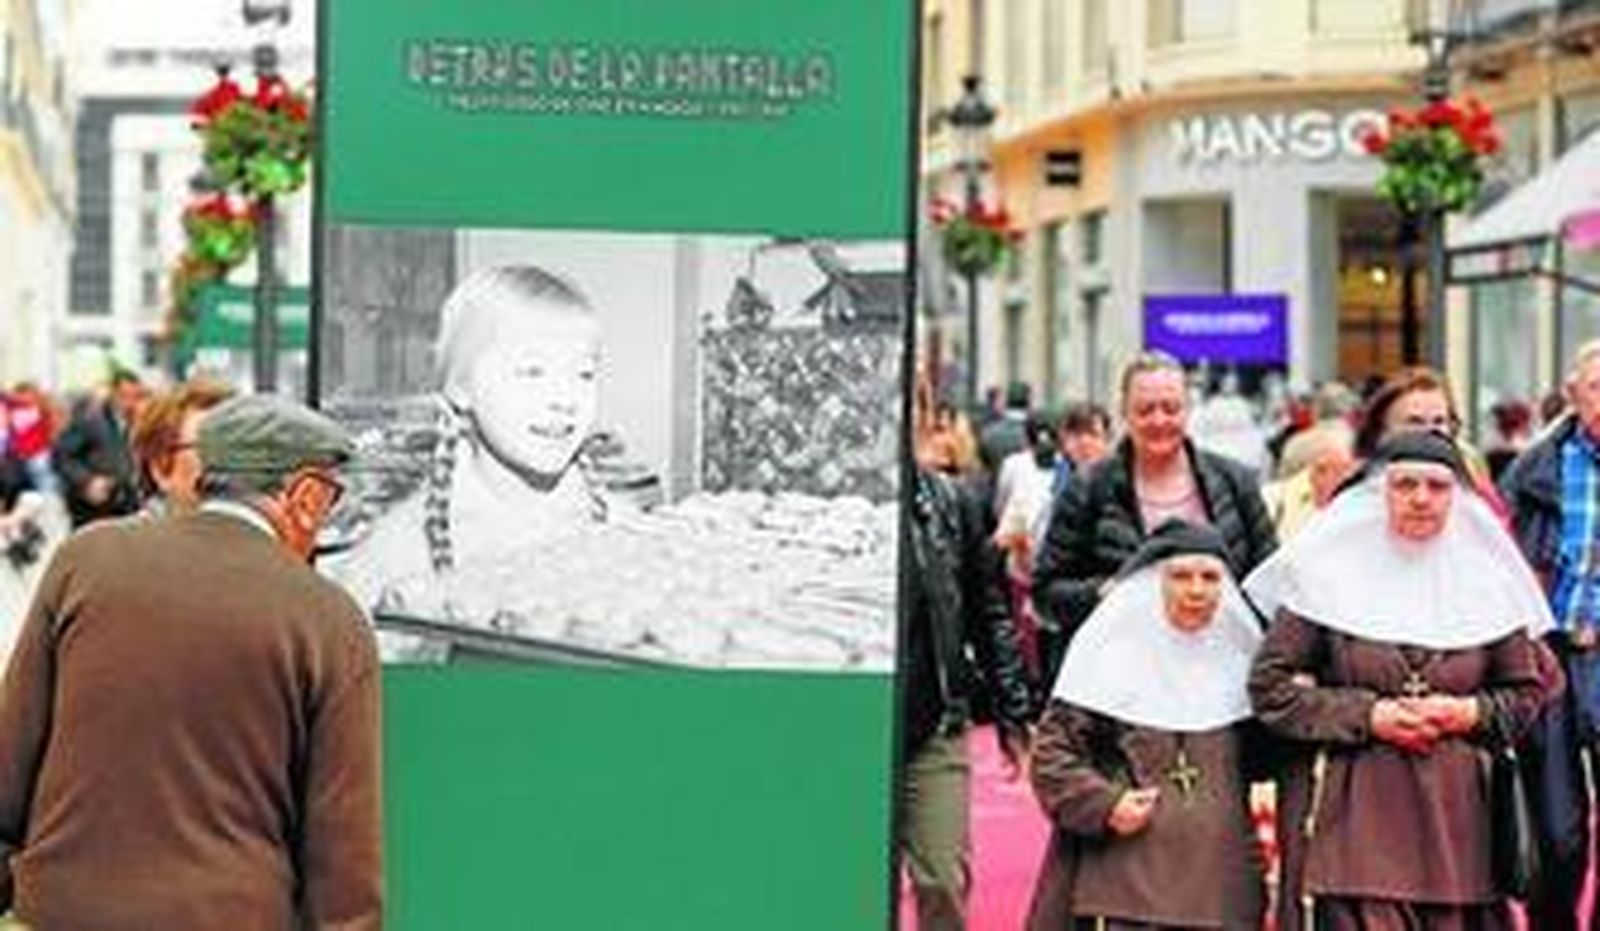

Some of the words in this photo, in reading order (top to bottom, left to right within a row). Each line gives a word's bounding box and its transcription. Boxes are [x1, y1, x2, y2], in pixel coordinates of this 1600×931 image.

[548, 46, 590, 90] DE
[600, 49, 644, 92] LA
[656, 52, 836, 98] PANTALLA
[1168, 107, 1390, 157] MANGO
